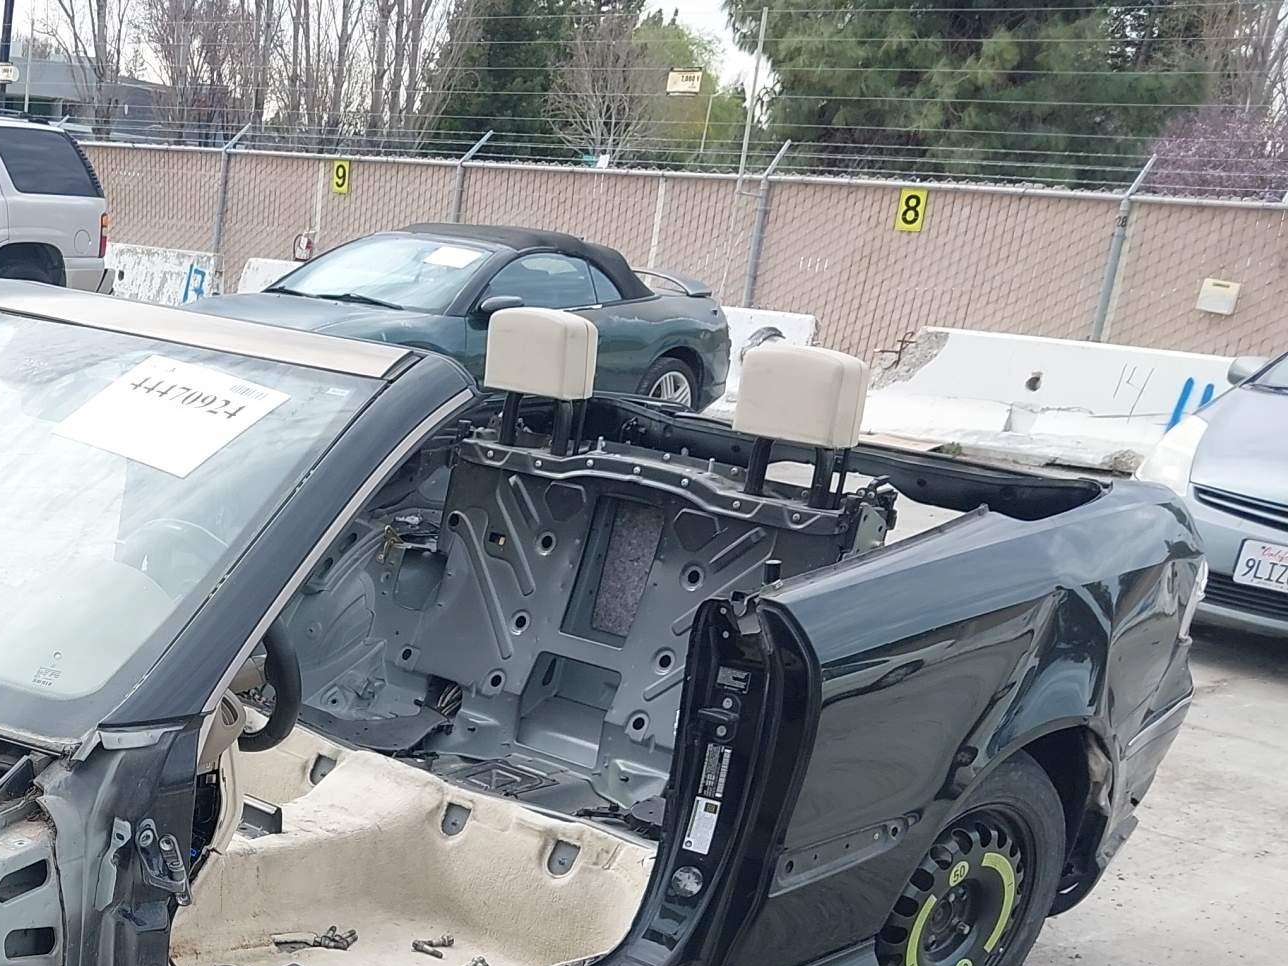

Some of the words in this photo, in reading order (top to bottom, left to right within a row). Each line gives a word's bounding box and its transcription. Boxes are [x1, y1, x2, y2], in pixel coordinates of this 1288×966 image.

[335, 164, 347, 188] 9
[902, 194, 921, 225] 8
[130, 376, 249, 420] 44470924
[1241, 557, 1288, 585] 9LIZ
[952, 864, 967, 884] 50
